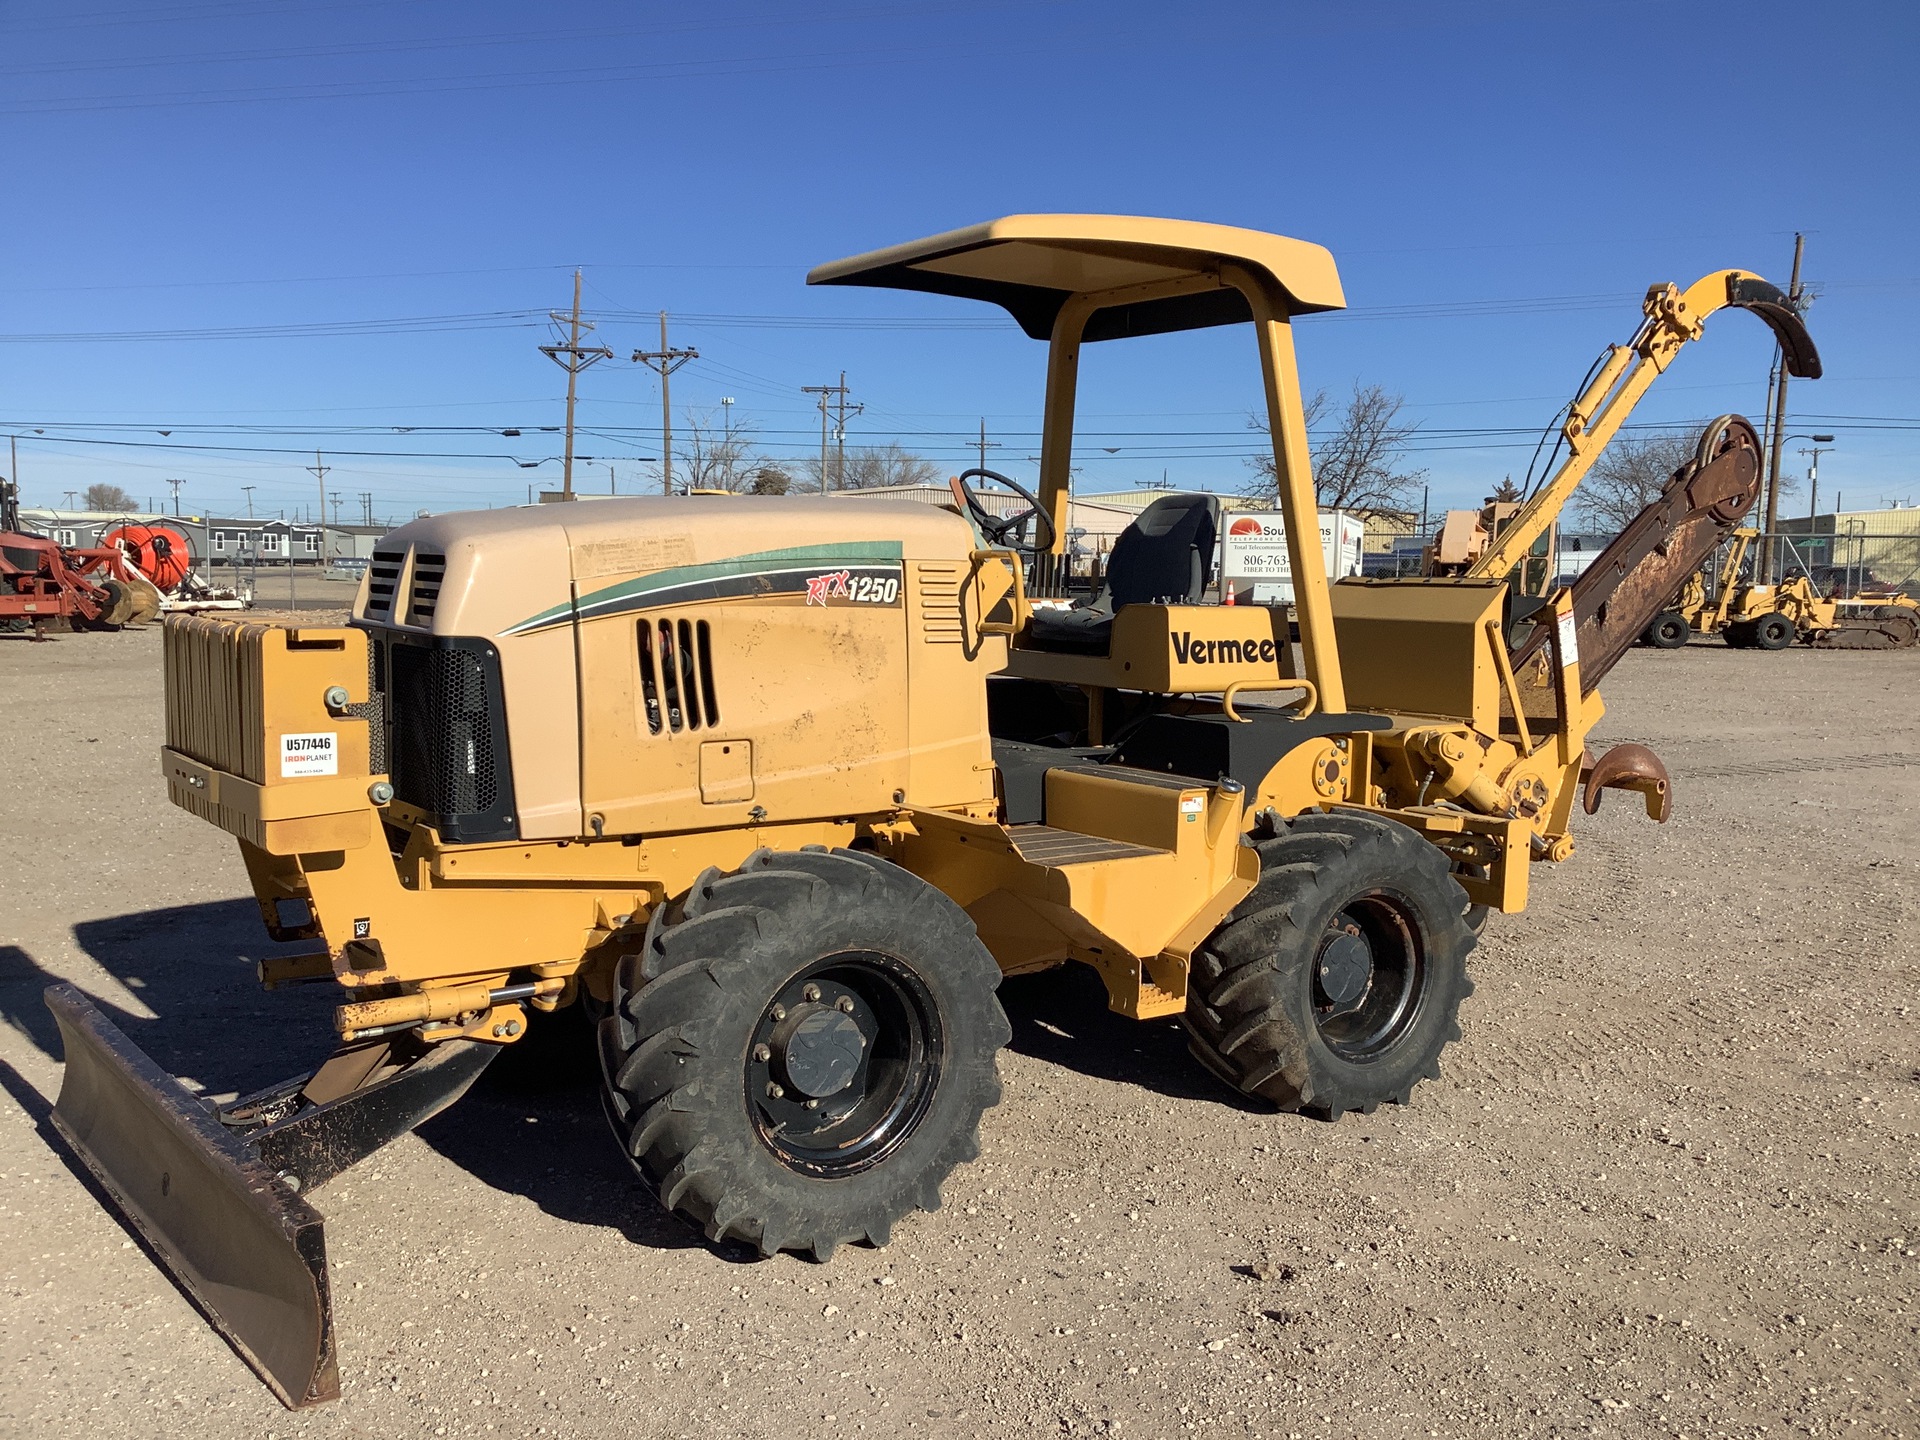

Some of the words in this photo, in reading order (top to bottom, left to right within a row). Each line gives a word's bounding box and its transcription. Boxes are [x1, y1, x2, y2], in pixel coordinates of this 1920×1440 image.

[806, 570, 850, 608] RTX
[848, 577, 899, 604] 1250
[1171, 632, 1285, 665] Vermeer
[286, 737, 331, 751] U577446
